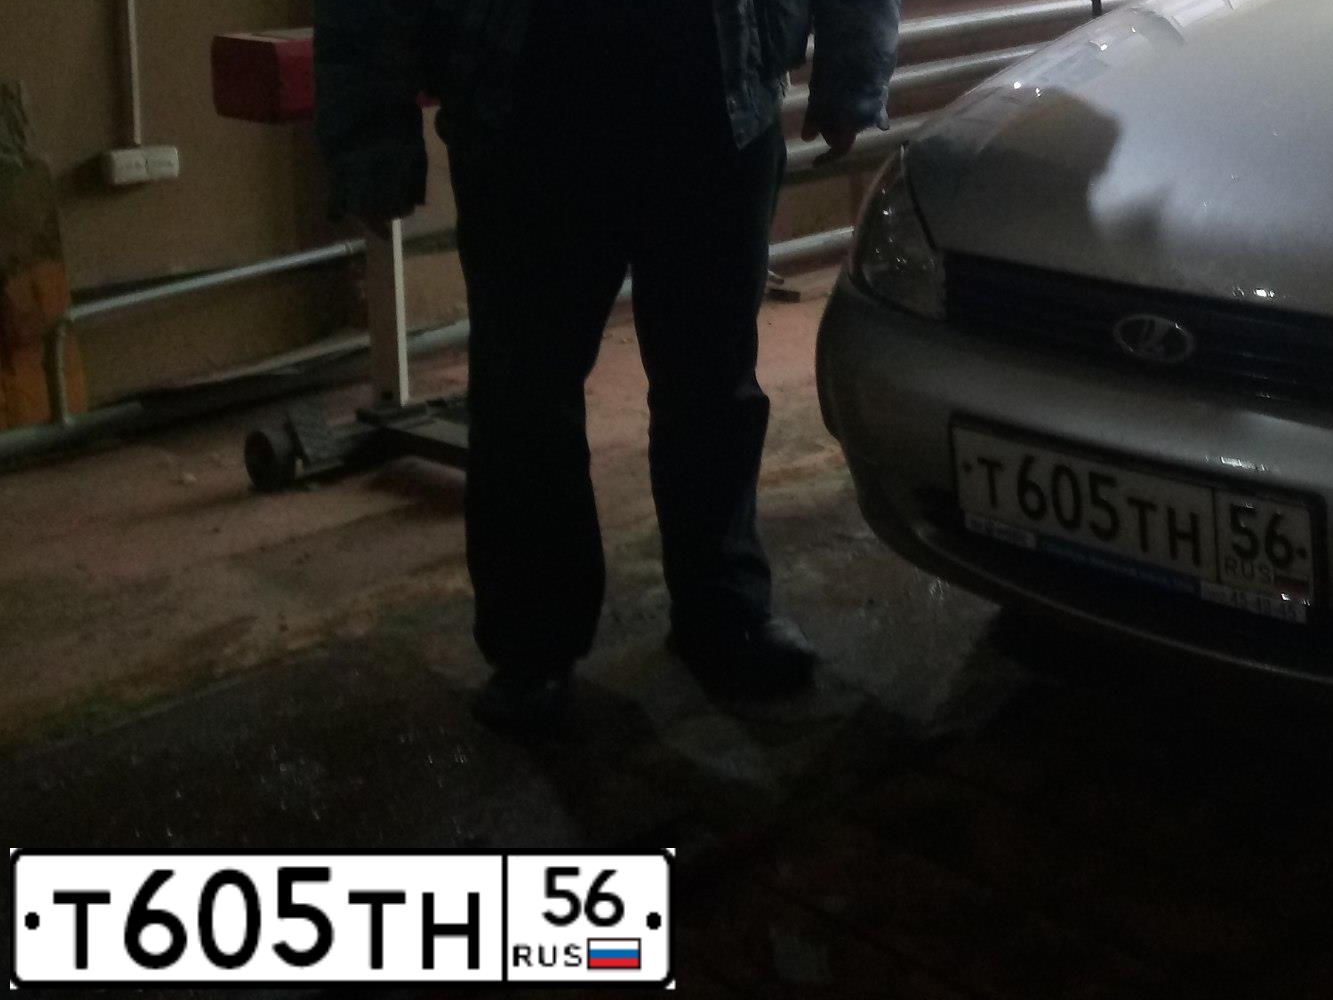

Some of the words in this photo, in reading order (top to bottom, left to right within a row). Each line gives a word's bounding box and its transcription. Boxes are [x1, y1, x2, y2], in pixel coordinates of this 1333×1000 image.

[977, 454, 1202, 566] Т605ТН
[1230, 503, 1295, 568] 56
[1224, 556, 1273, 584] RUS
